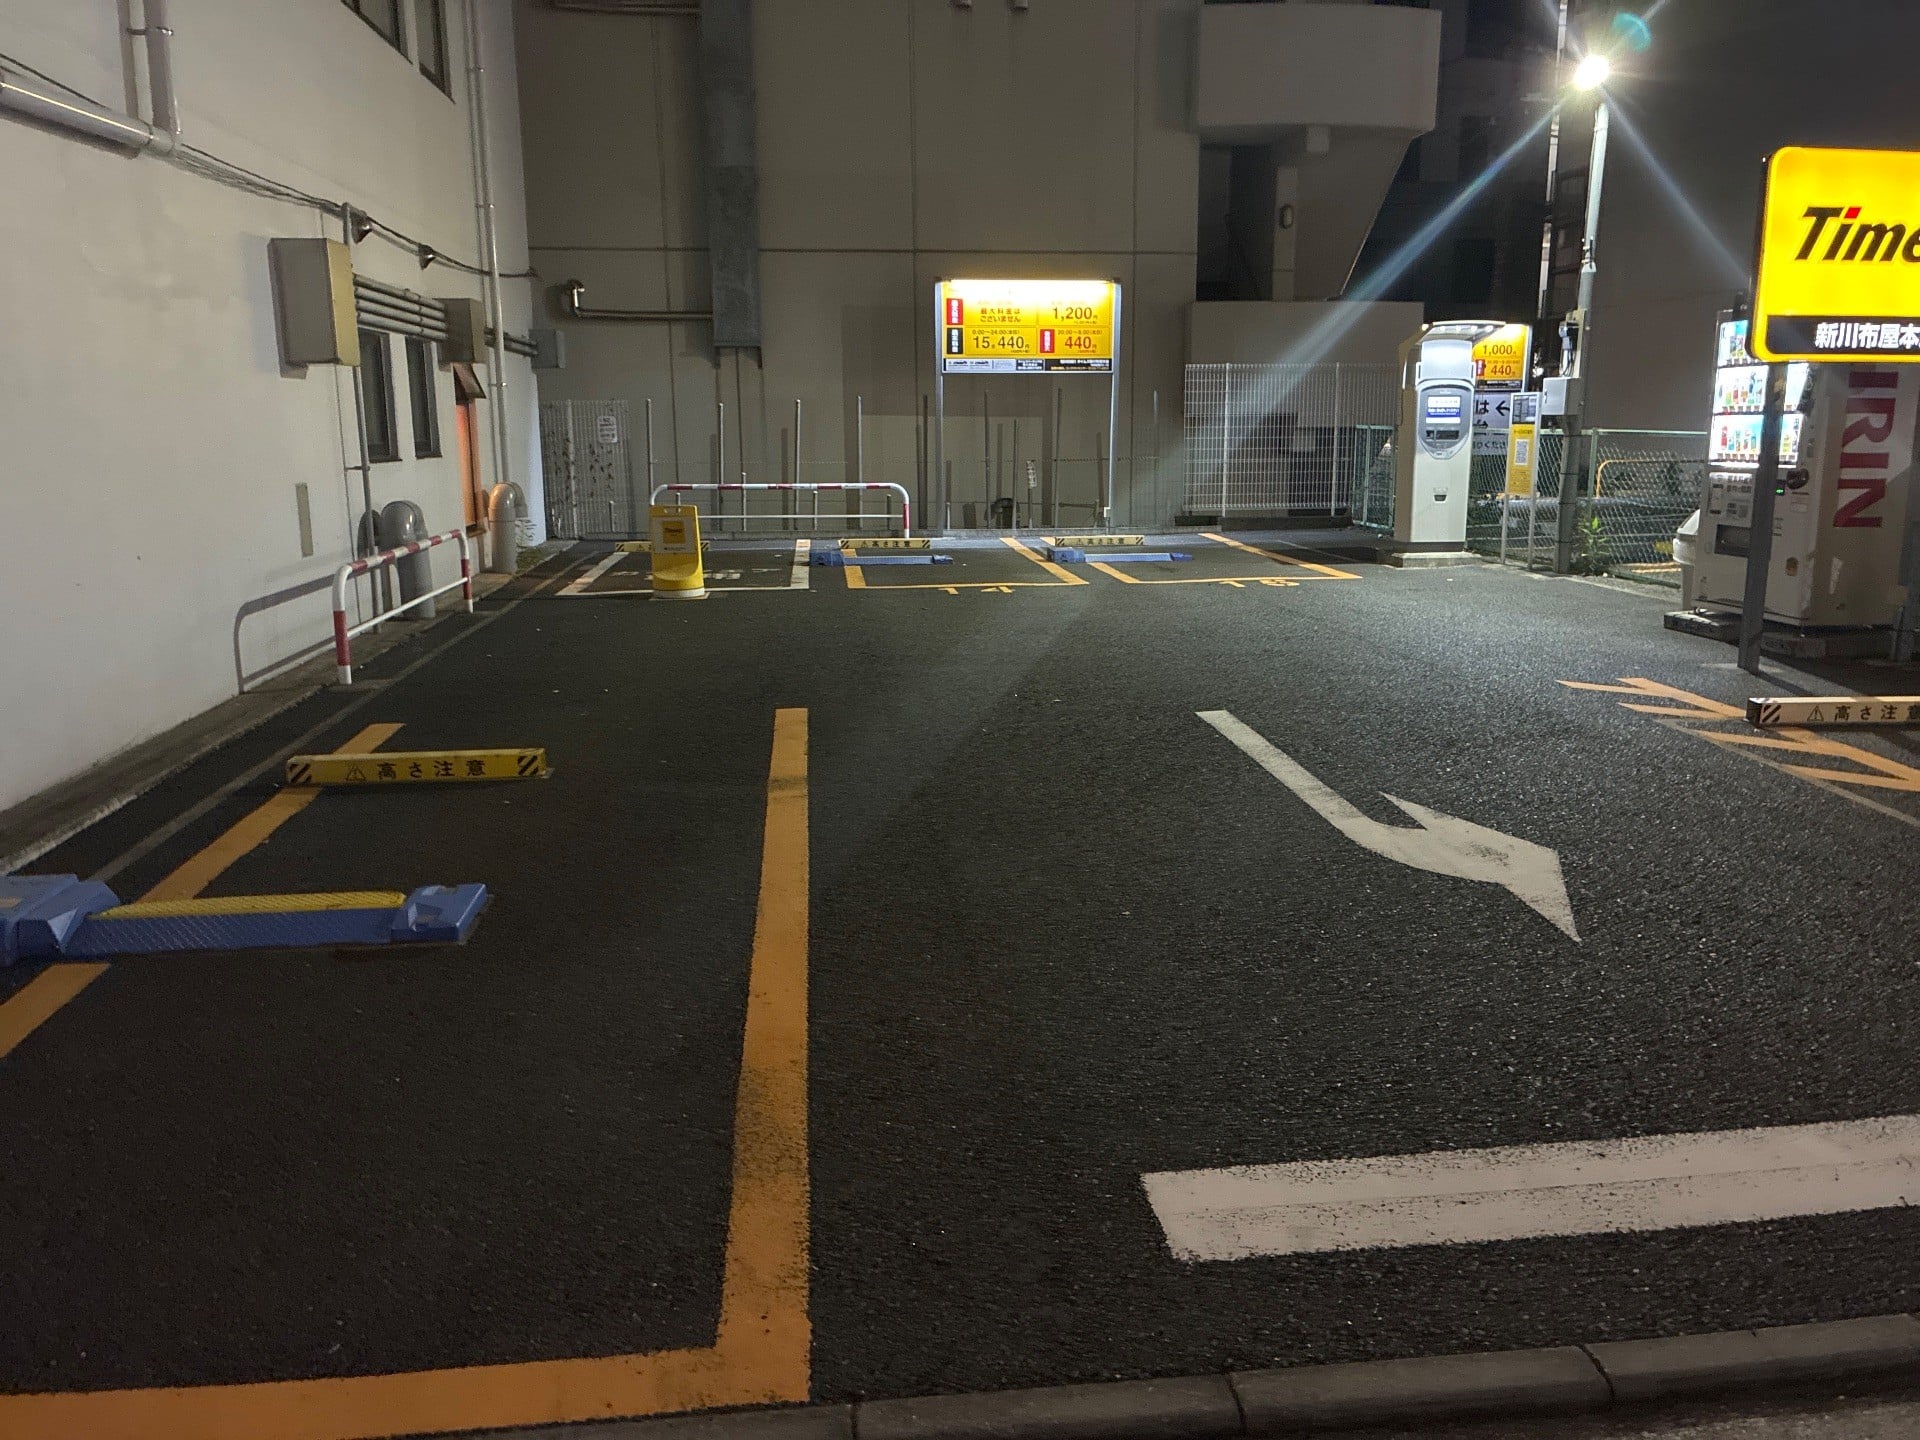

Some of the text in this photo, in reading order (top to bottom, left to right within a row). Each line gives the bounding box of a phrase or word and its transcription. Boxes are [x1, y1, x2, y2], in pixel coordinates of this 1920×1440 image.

[1794, 206, 1920, 263] Time
[1814, 322, 1920, 349] 新川布屋本
[1832, 371, 1899, 528] IRIN
[1834, 705, 1920, 721] 高さ注意
[376, 759, 486, 779] 高さ注意
